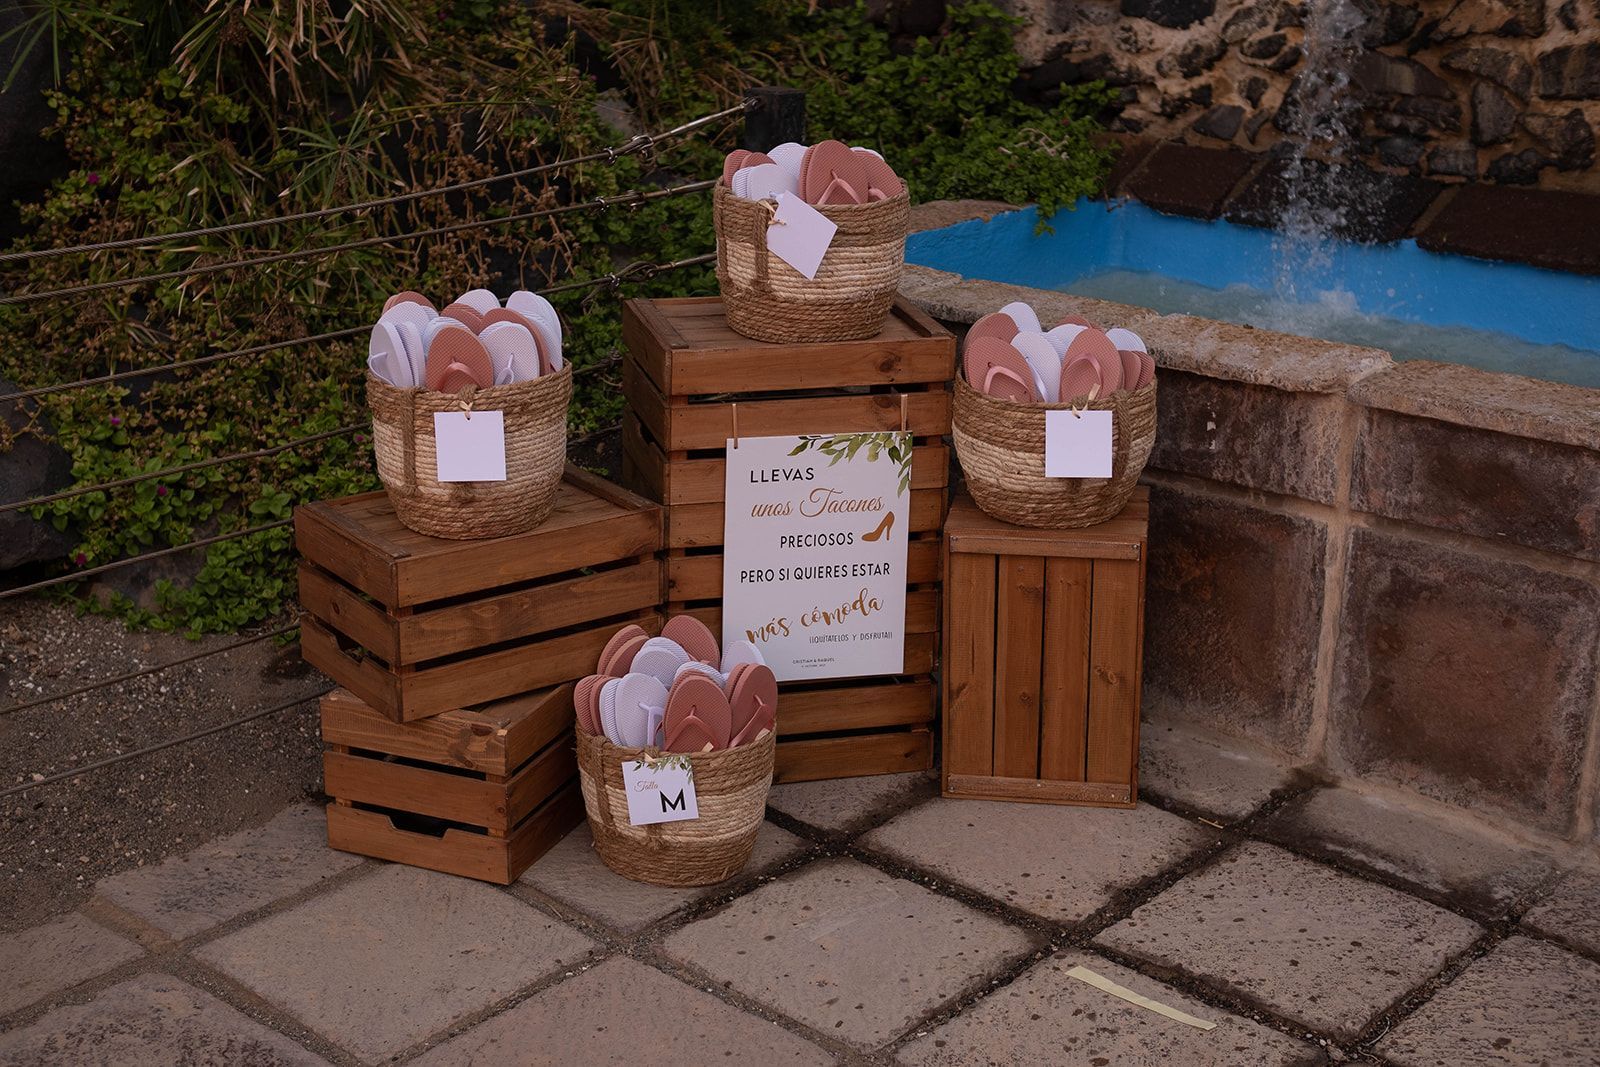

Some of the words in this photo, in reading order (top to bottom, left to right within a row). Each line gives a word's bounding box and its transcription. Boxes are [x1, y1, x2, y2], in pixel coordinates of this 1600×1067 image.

[750, 467, 815, 483] LLEVAS
[751, 501, 793, 517] unos
[800, 487, 885, 517] Tacones
[780, 532, 854, 548] PRECIOSOS
[740, 569, 775, 583] PERO
[778, 568, 790, 581] SI
[793, 564, 848, 580] QUIERES
[852, 562, 890, 577] ESTAR
[745, 617, 794, 644] más
[800, 587, 885, 627] cómoda
[634, 781, 658, 792] Talla
[660, 788, 686, 813] M
